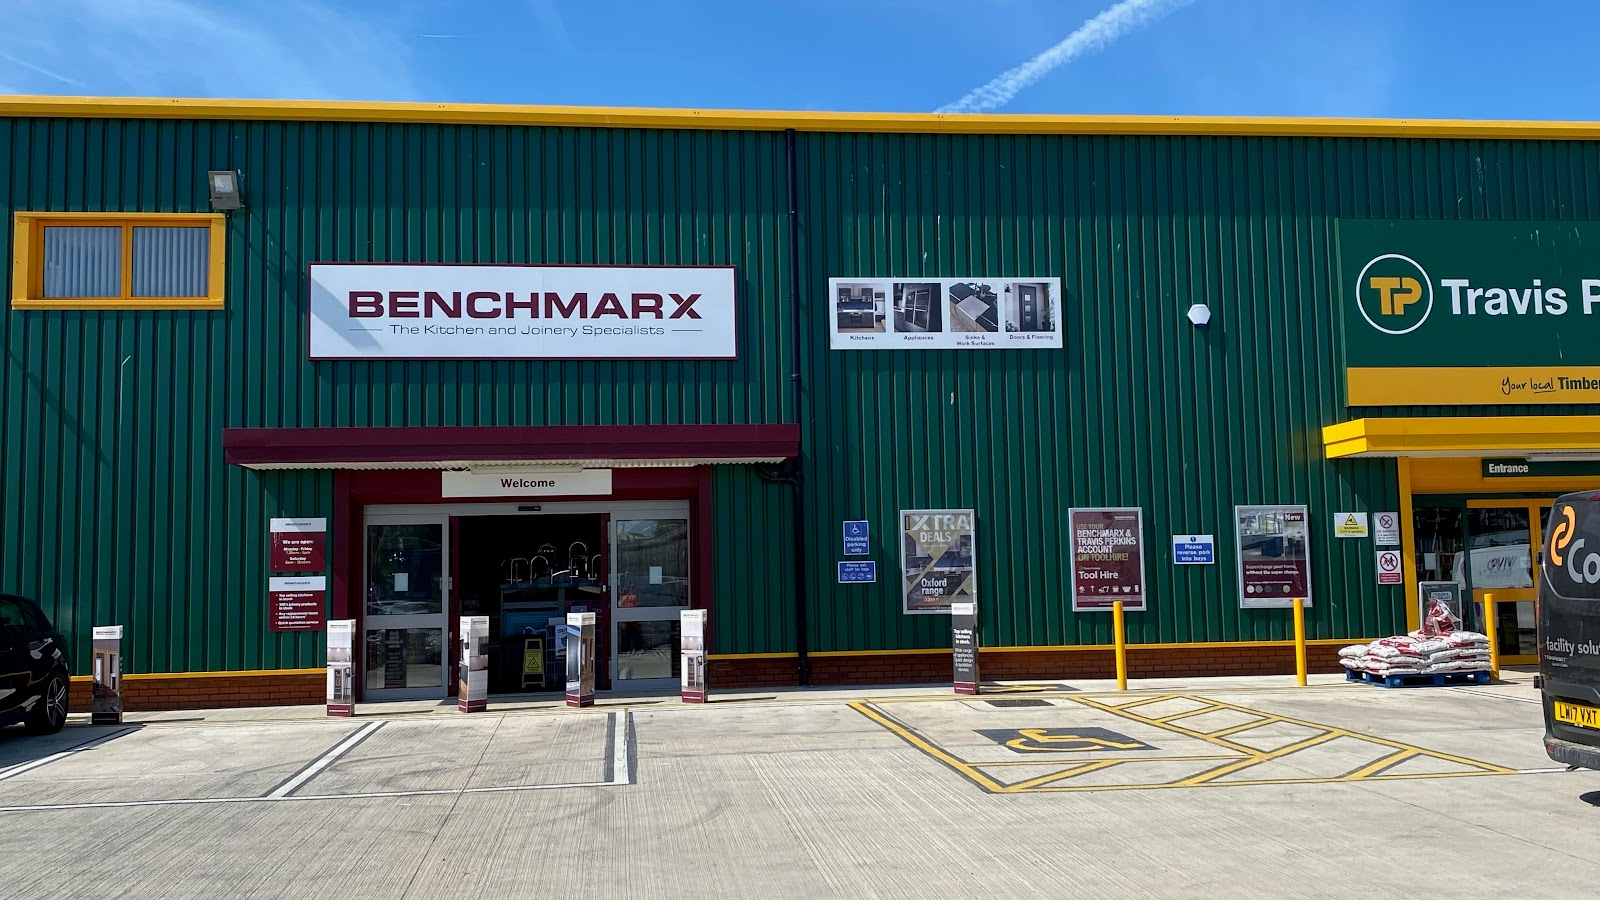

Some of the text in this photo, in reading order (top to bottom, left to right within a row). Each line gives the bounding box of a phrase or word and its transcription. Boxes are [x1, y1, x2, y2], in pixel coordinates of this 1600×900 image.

[1370, 277, 1422, 315] TP
[1441, 279, 1568, 315] Travis
[348, 290, 703, 319] BENCHMARX
[389, 324, 665, 337] The Kitchen and Joinery Specialists
[1501, 376, 1600, 395] Your local Timbe
[1489, 463, 1529, 473] Entrance
[501, 479, 555, 488] Welcome
[920, 532, 952, 542] DEALS
[1077, 529, 1131, 538] BENCHMARX &
[1077, 537, 1136, 545] TRAVIS PERKINS
[1078, 545, 1113, 553] ACCOUNT
[1078, 553, 1089, 561] ON
[1078, 571, 1118, 579] Tool Hire
[921, 578, 947, 587] Oxford
[921, 587, 944, 596] range
[1546, 636, 1600, 656] facility solu
[1580, 707, 1597, 725] VXT
